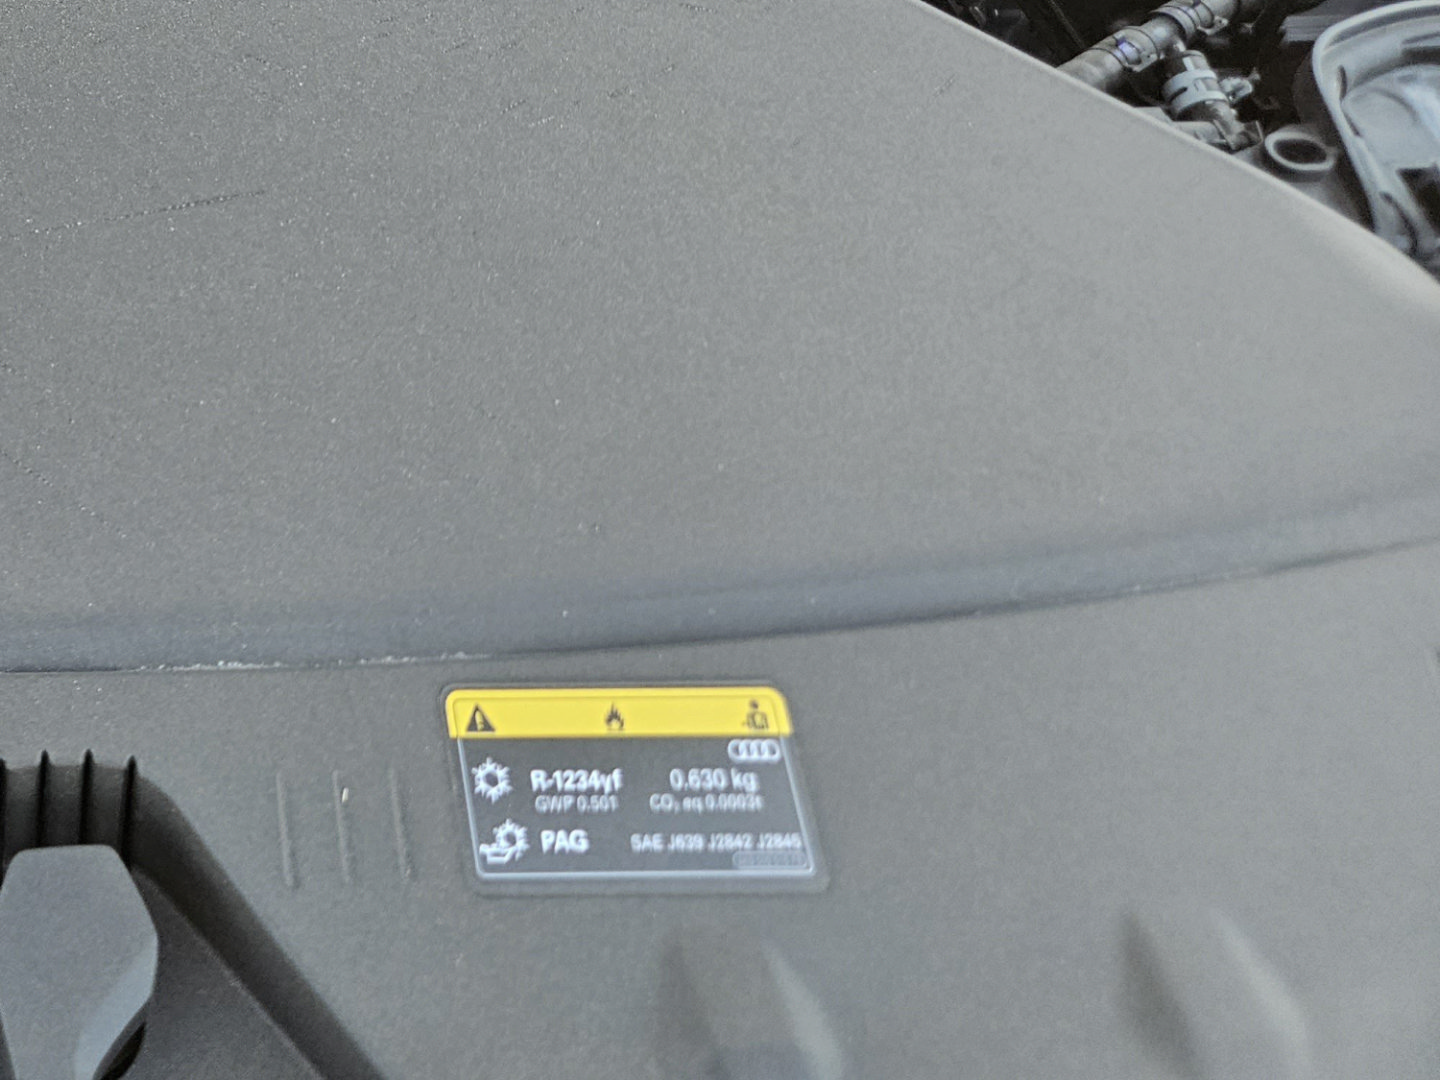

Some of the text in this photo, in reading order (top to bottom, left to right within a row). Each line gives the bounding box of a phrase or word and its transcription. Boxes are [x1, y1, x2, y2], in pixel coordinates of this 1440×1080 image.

[530, 768, 623, 794] R-1234yf
[669, 767, 759, 793] 0.630 kg
[535, 795, 575, 813] GWP
[541, 829, 590, 854] PAG
[630, 833, 663, 852] SAE
